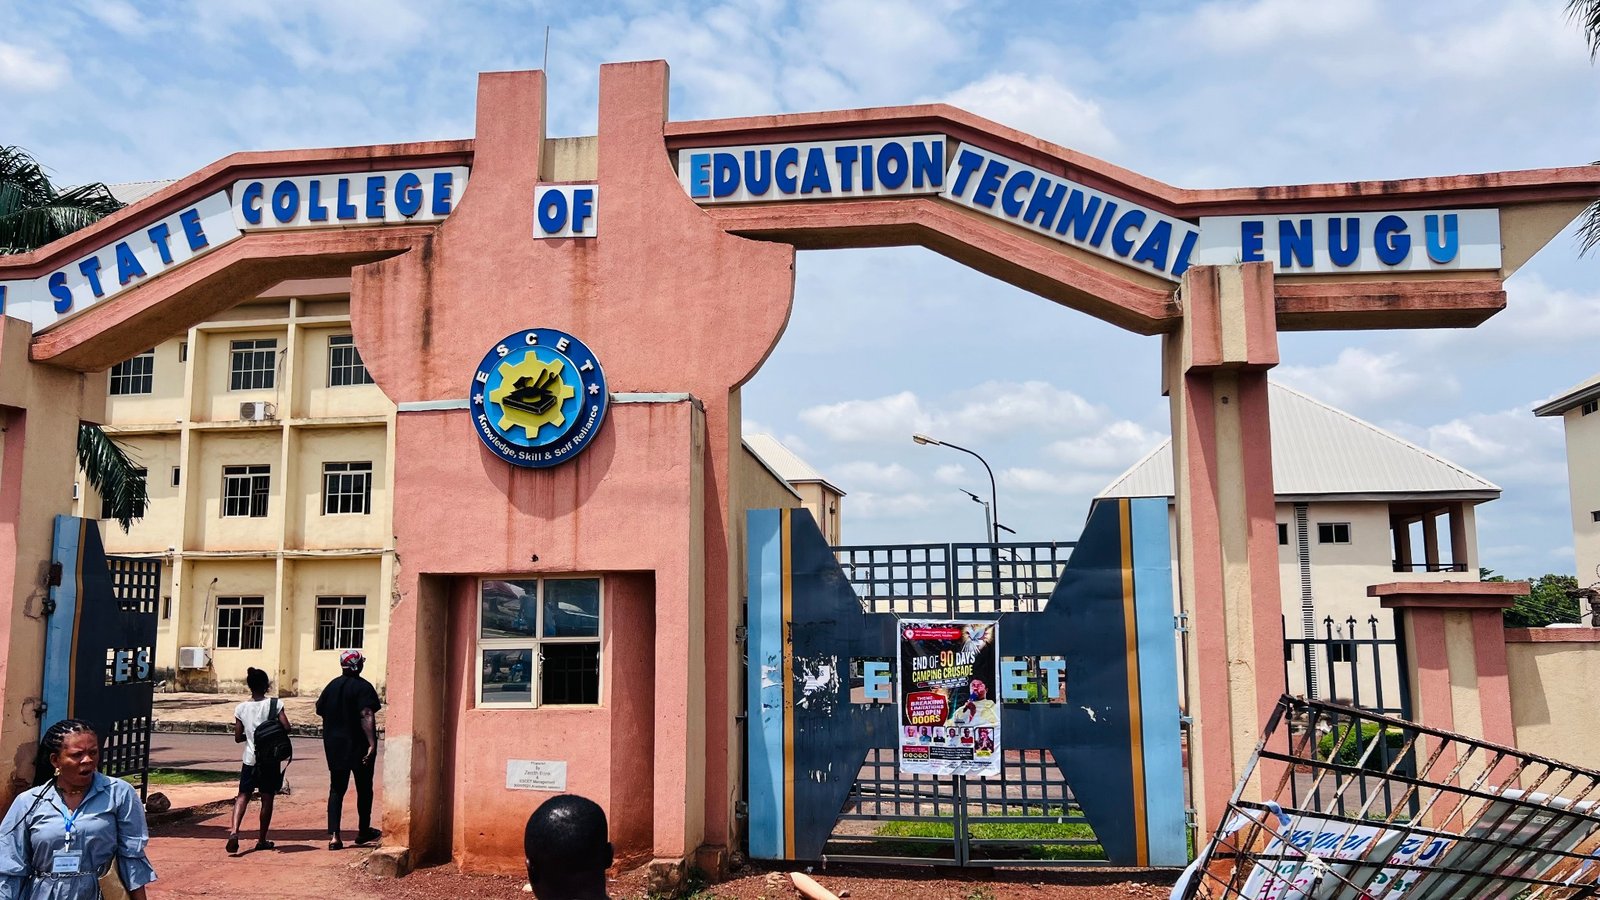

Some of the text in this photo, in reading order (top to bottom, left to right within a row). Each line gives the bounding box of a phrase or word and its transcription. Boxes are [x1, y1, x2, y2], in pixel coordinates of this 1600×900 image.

[48, 207, 210, 314] STATE
[241, 171, 454, 225] COLLEGE
[537, 188, 594, 234] OF
[690, 141, 944, 199] EDUCATION
[955, 149, 1200, 277] TECHNICAL
[1240, 213, 1460, 268] ENUGU
[476, 332, 595, 385] ESCET
[477, 405, 599, 461] Knowledge, Skill & Self Reliance
[912, 650, 976, 671] END OF 90 DAYS
[912, 664, 974, 682] CAMPING CRUSADE
[912, 715, 941, 725] DOORS
